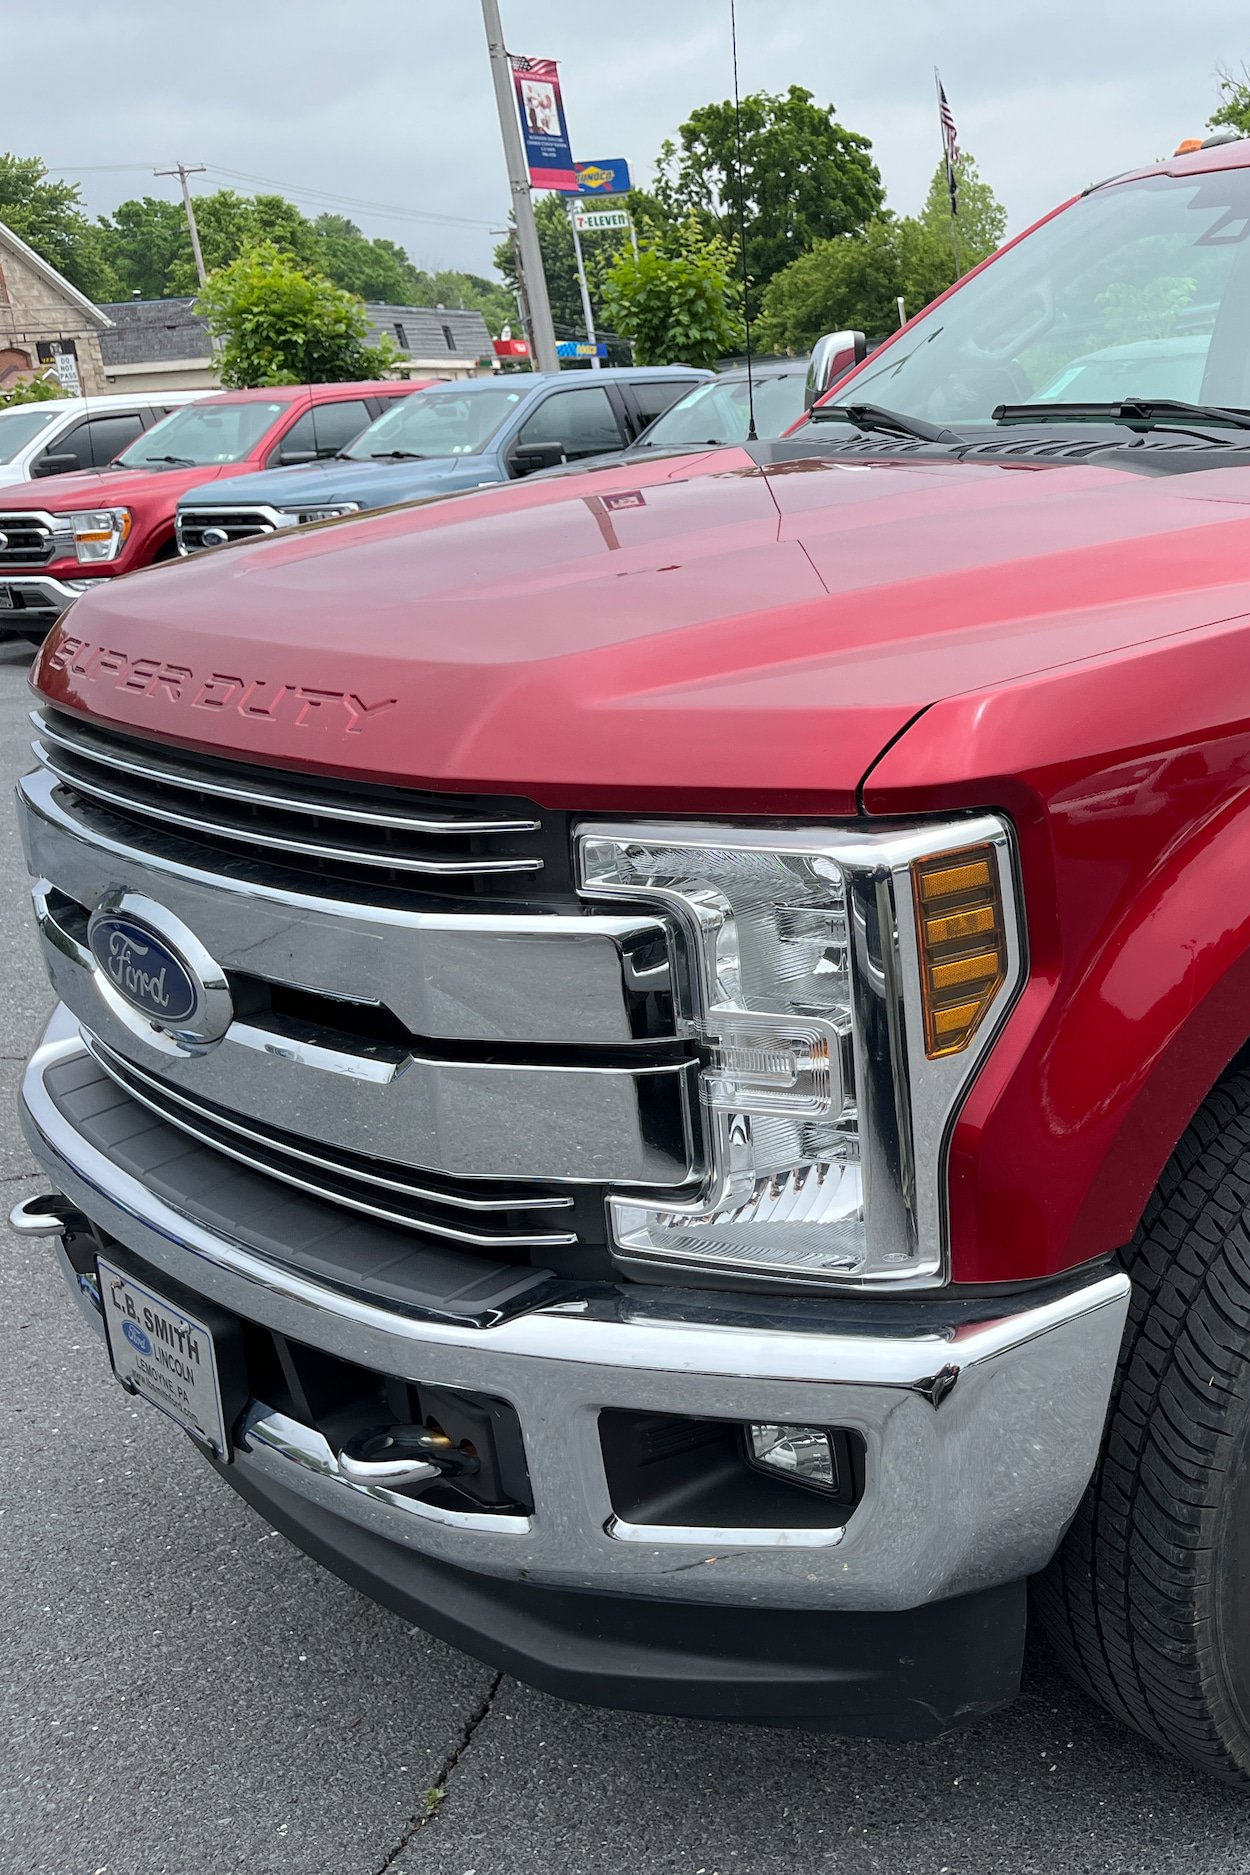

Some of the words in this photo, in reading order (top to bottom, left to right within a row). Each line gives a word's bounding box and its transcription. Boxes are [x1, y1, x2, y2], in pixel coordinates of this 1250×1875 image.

[576, 214, 626, 228] 7-ELEVEN
[49, 636, 193, 703] SUPER
[191, 673, 398, 734] DUTY
[108, 931, 170, 1008] Ford
[143, 1307, 201, 1366] SMITH
[153, 1343, 195, 1387] LINCOLN
[177, 1385, 190, 1405] PA
